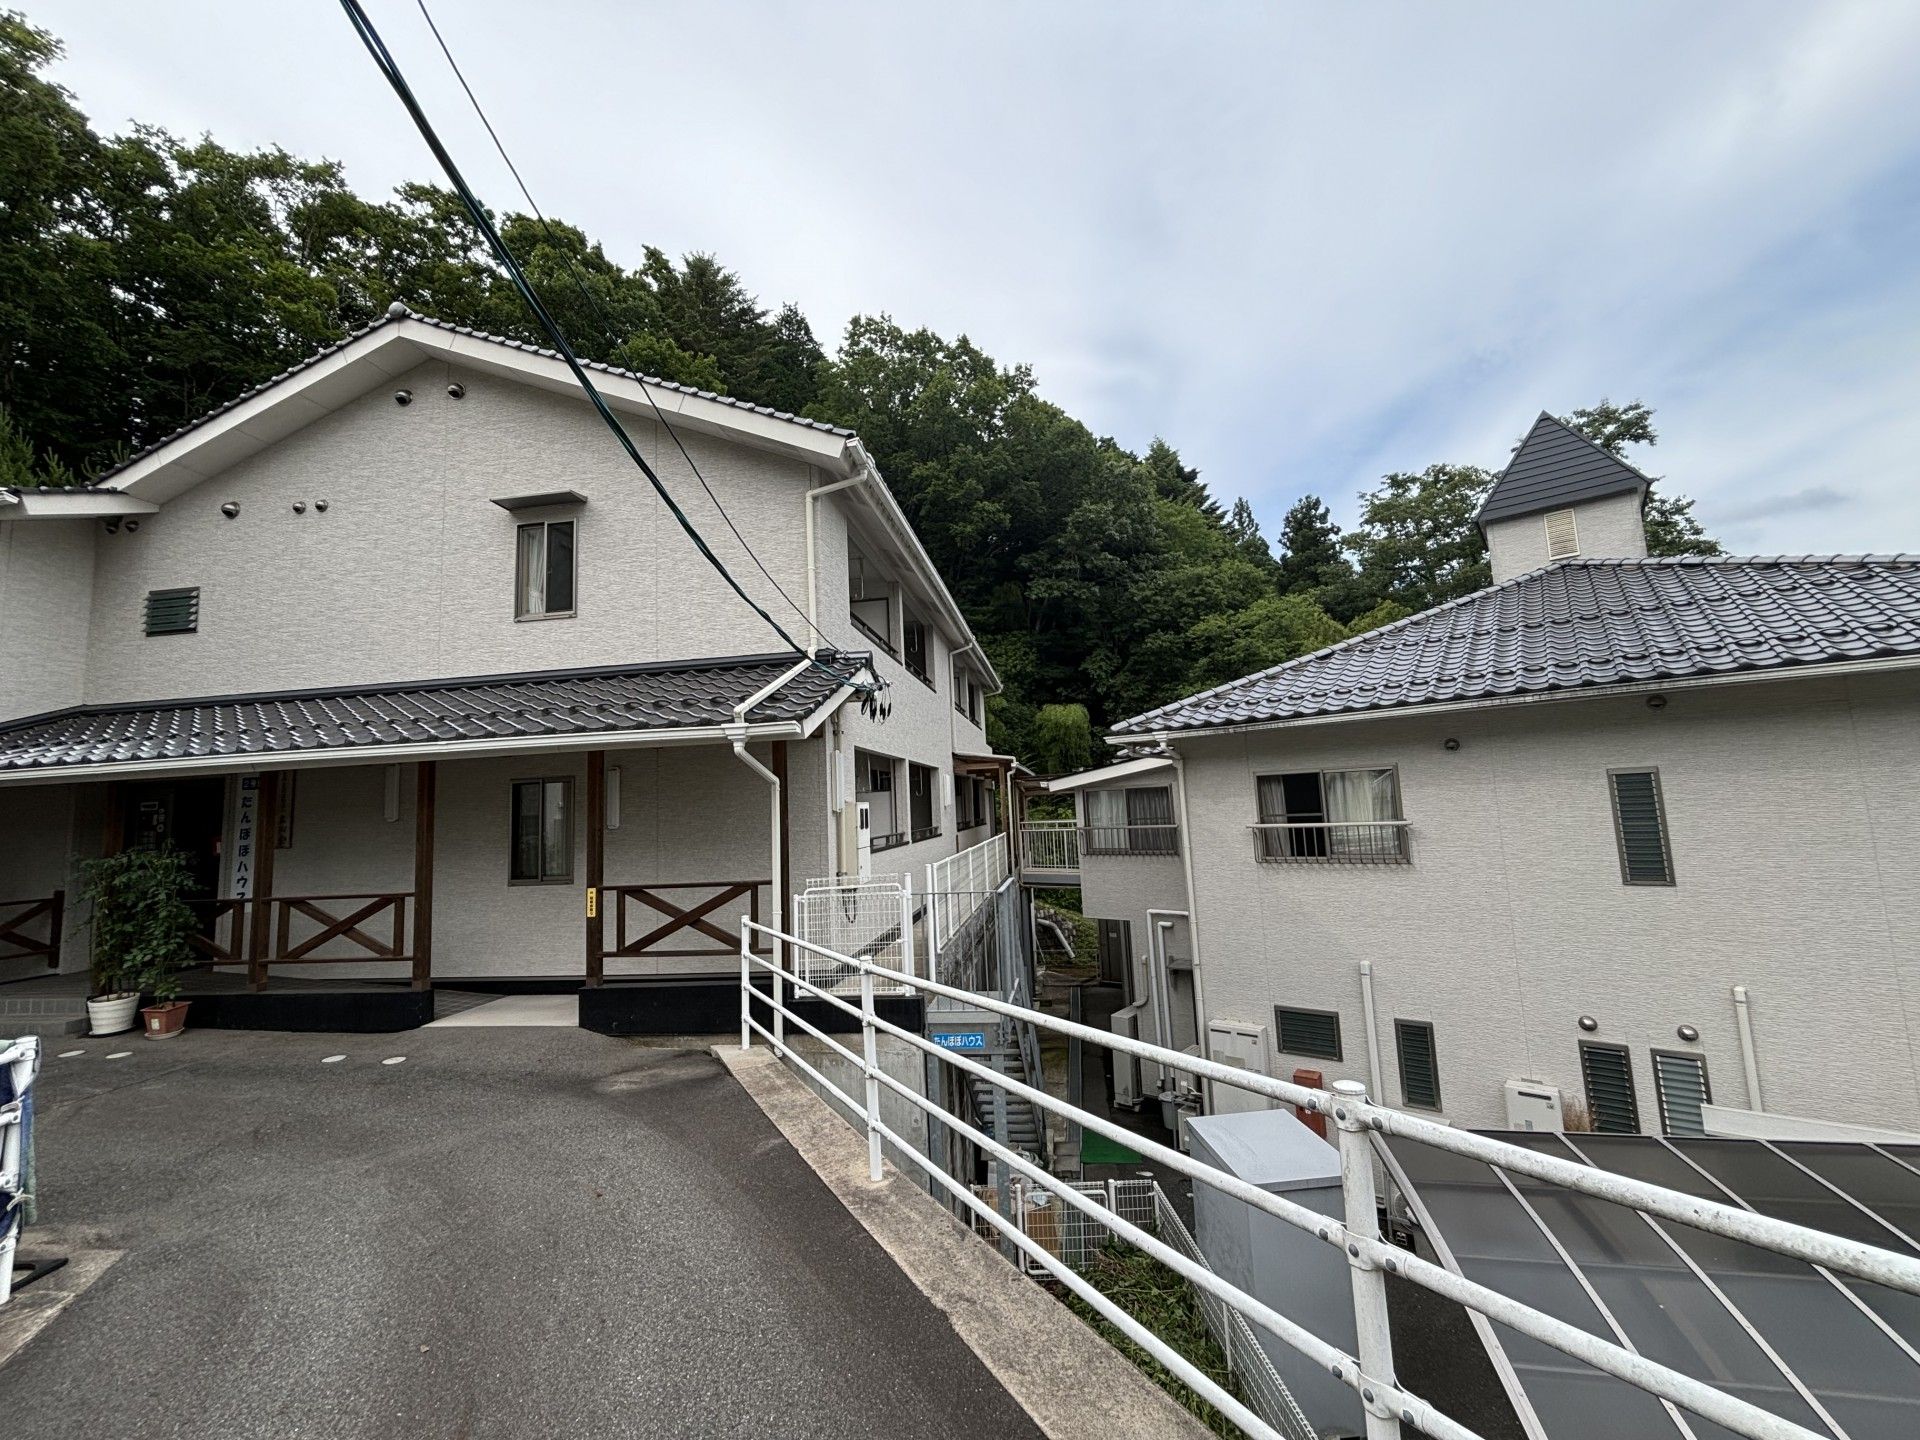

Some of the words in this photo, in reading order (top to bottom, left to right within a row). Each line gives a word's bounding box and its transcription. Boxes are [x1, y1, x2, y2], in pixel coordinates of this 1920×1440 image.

[934, 1035, 983, 1047] たんぽぽハウス
